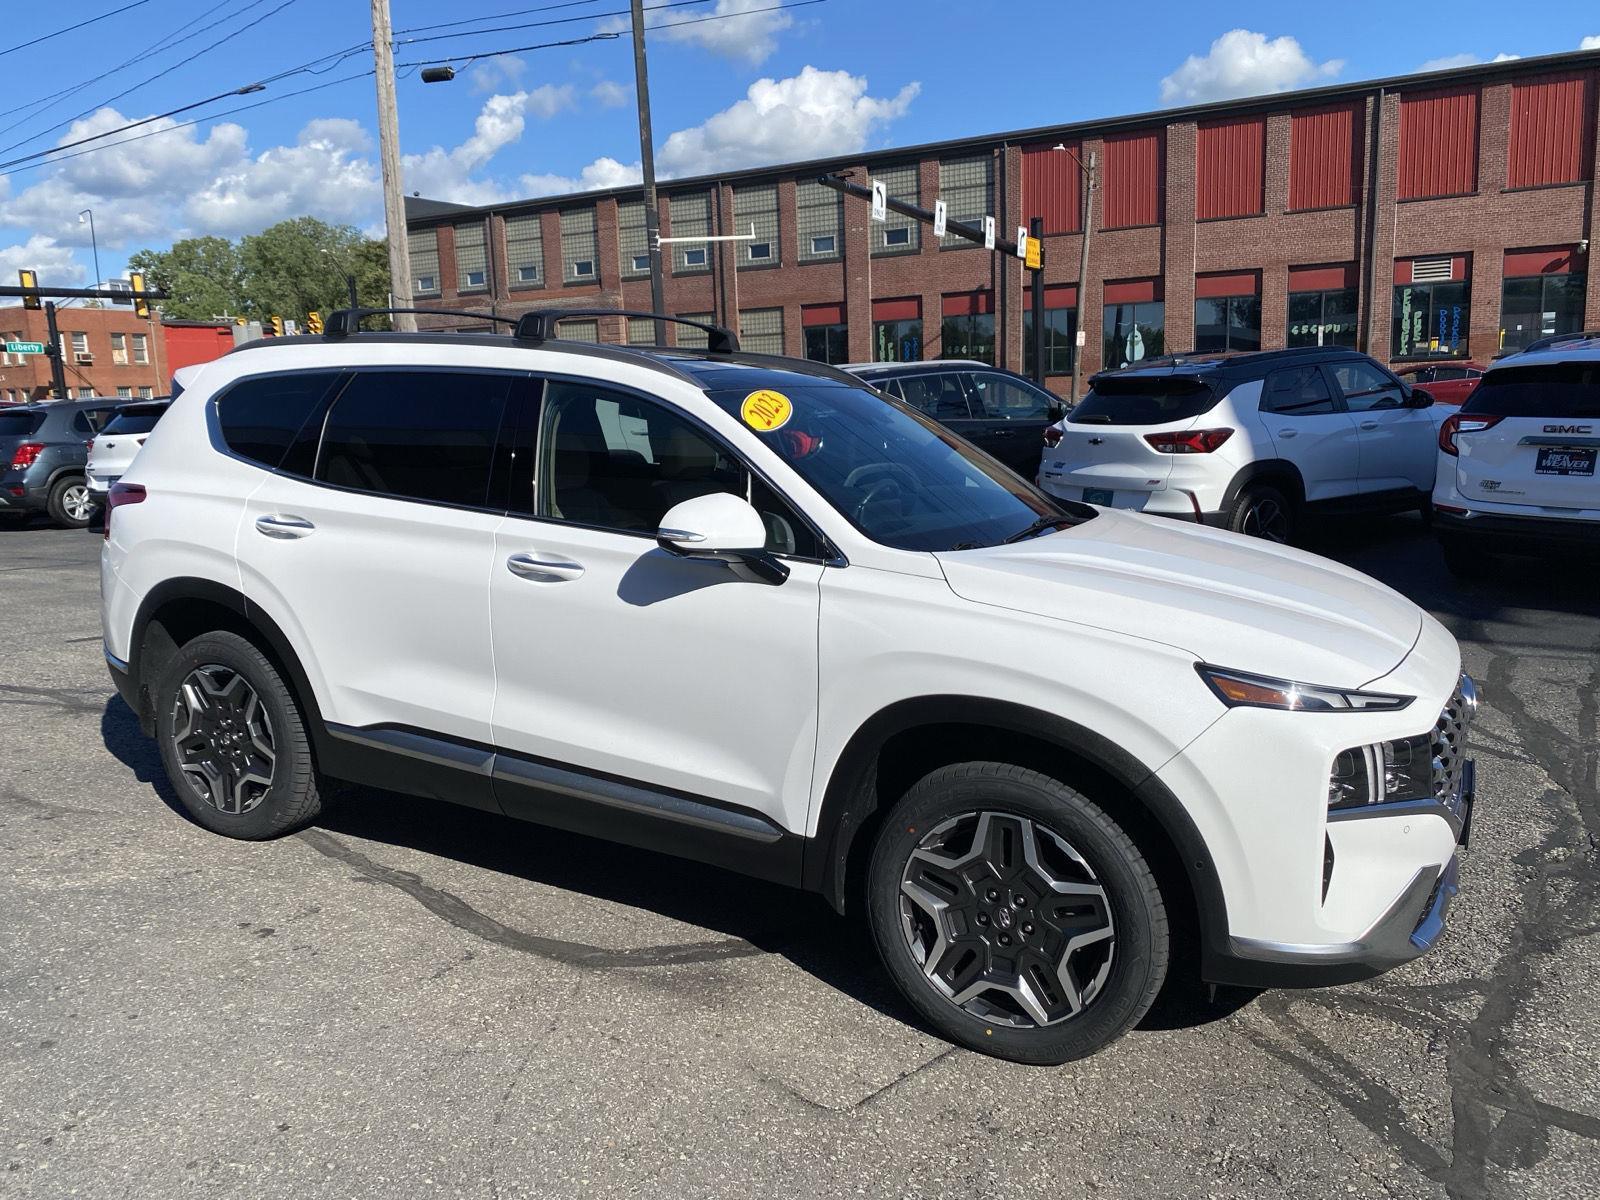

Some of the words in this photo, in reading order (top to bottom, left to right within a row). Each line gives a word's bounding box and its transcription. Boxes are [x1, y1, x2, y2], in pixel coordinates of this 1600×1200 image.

[11, 343, 39, 352] Liberty
[749, 393, 783, 426] 2023
[1543, 425, 1592, 434] GMC
[1541, 459, 1589, 468] WEAVER
